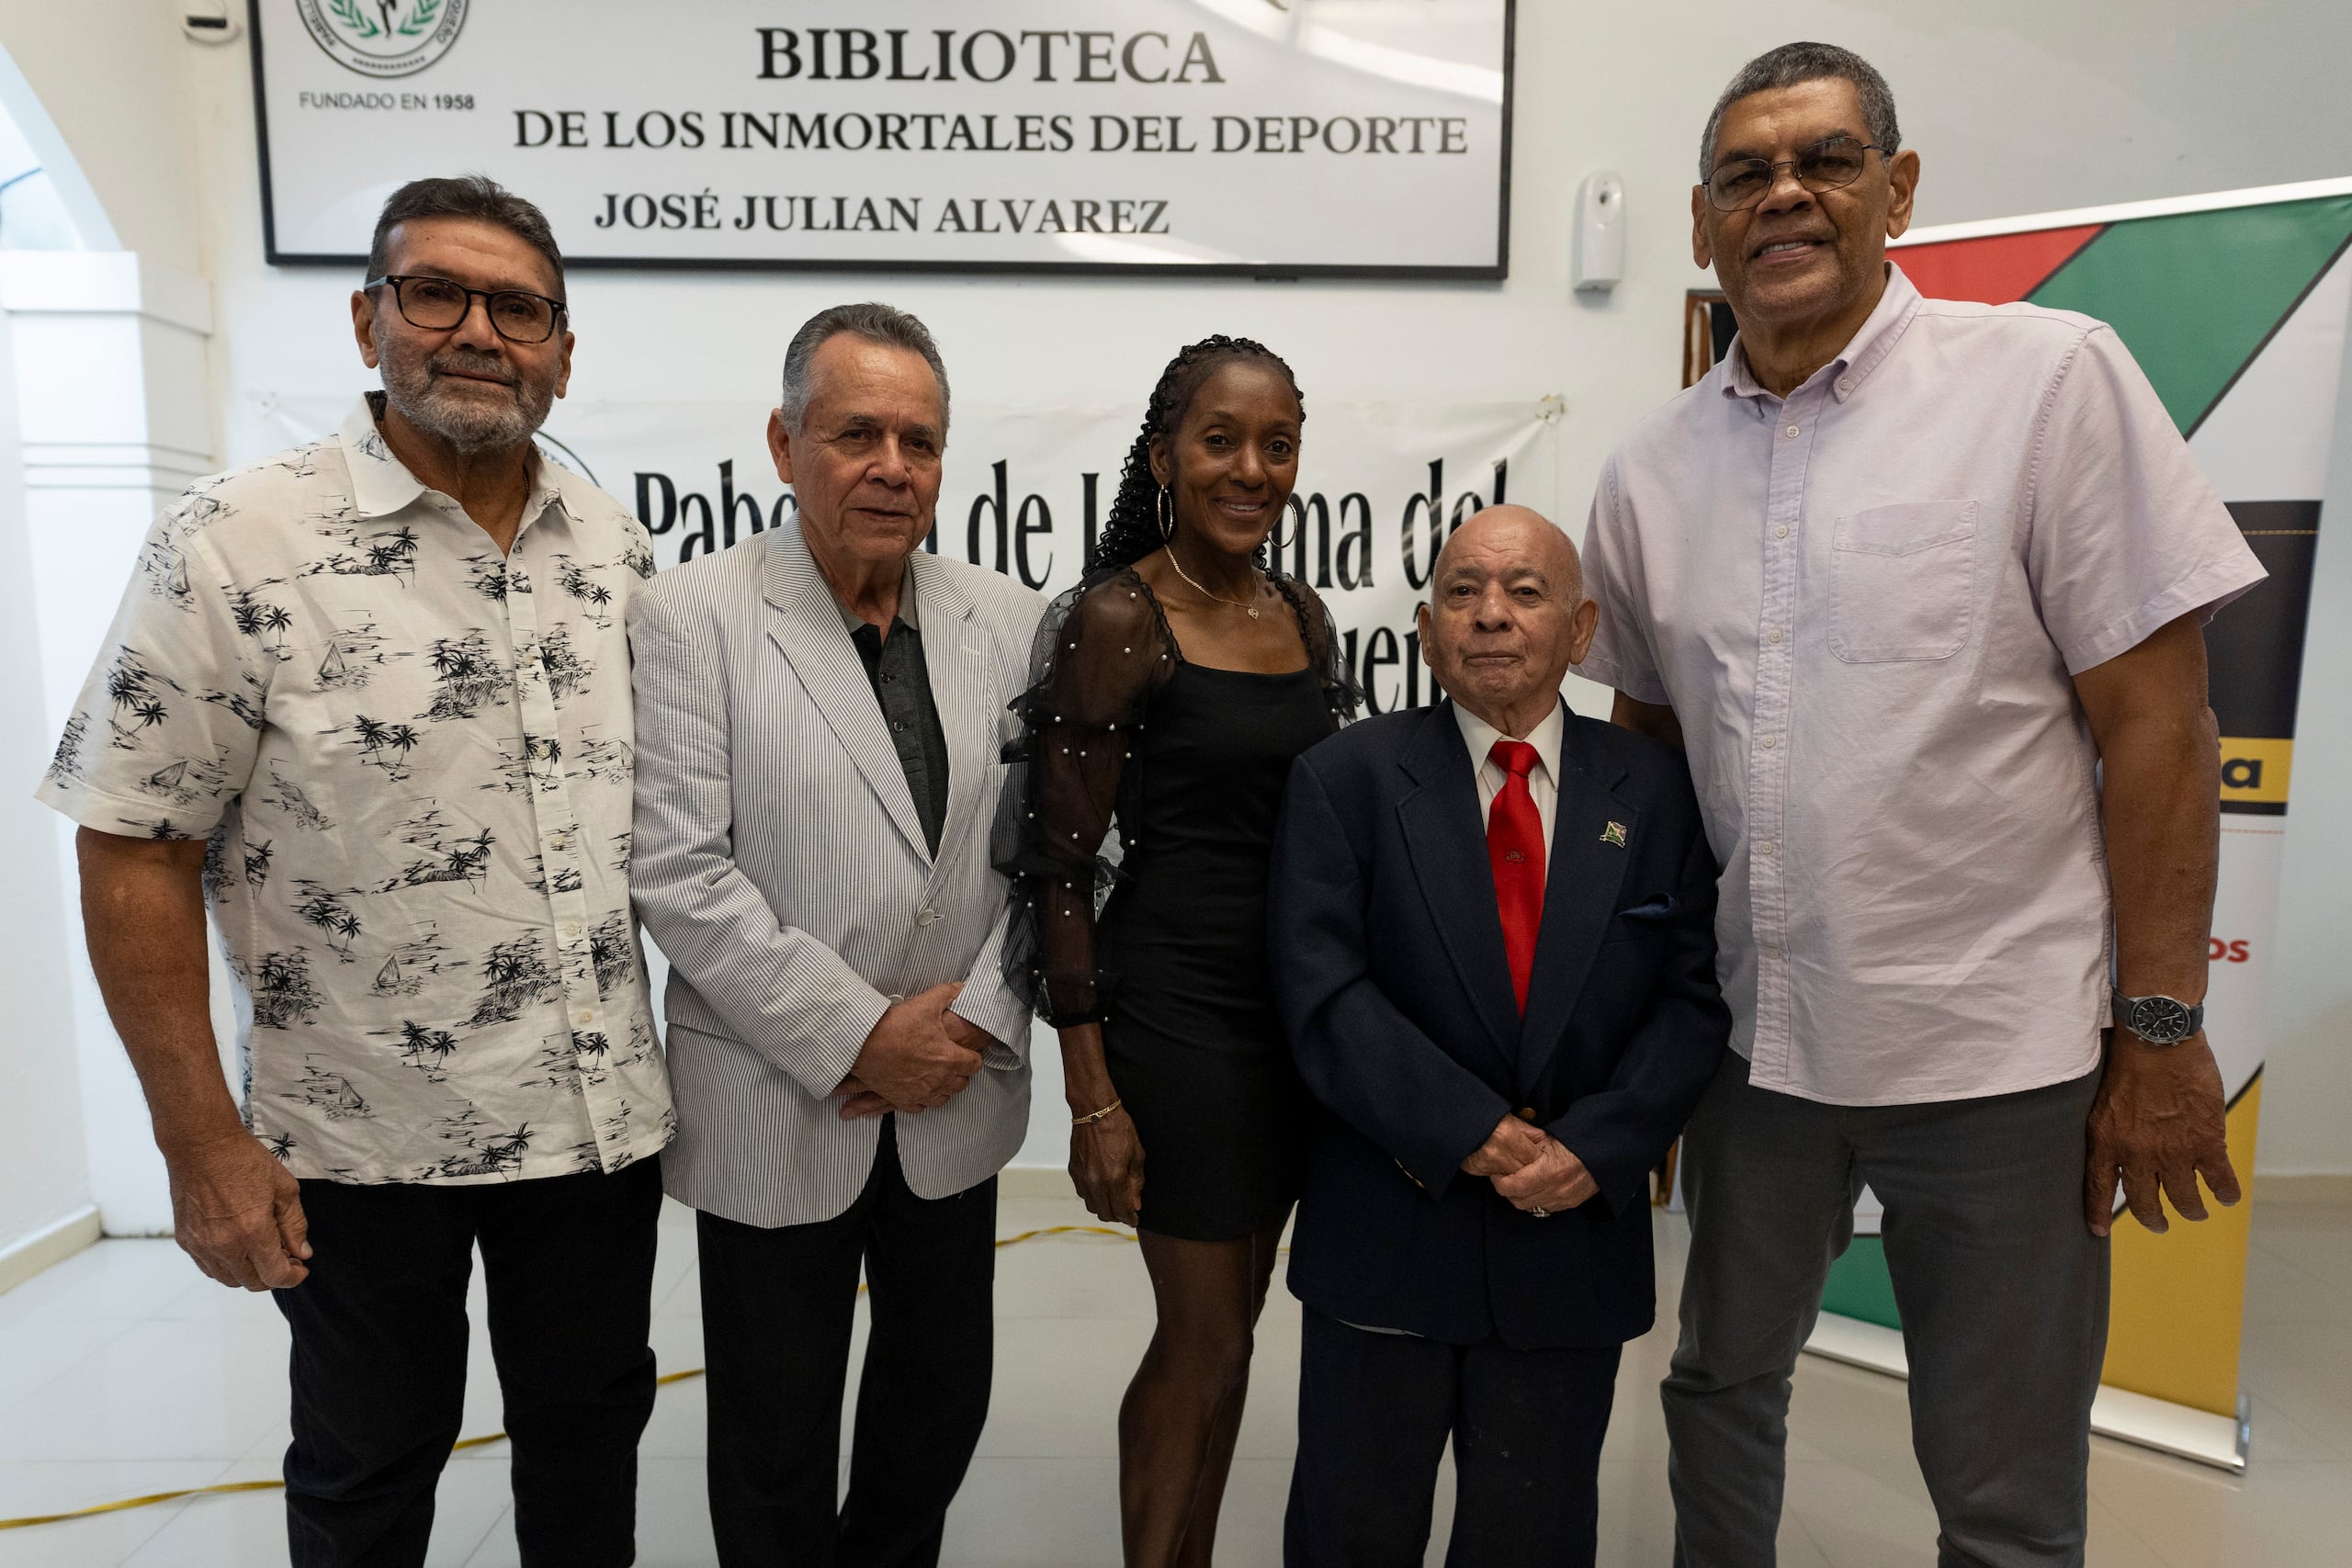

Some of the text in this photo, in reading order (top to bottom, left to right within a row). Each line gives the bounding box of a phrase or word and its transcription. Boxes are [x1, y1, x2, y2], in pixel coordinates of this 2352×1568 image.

[754, 28, 1226, 84] BIBLIOTECA
[299, 92, 475, 111] FUNDADO EN 1958
[514, 110, 1468, 154] DE LOS INMORTALES DEL DEPORTE
[594, 187, 1170, 234] JOSÉ JULIAN ALVAREZ
[967, 458, 1054, 591] de
